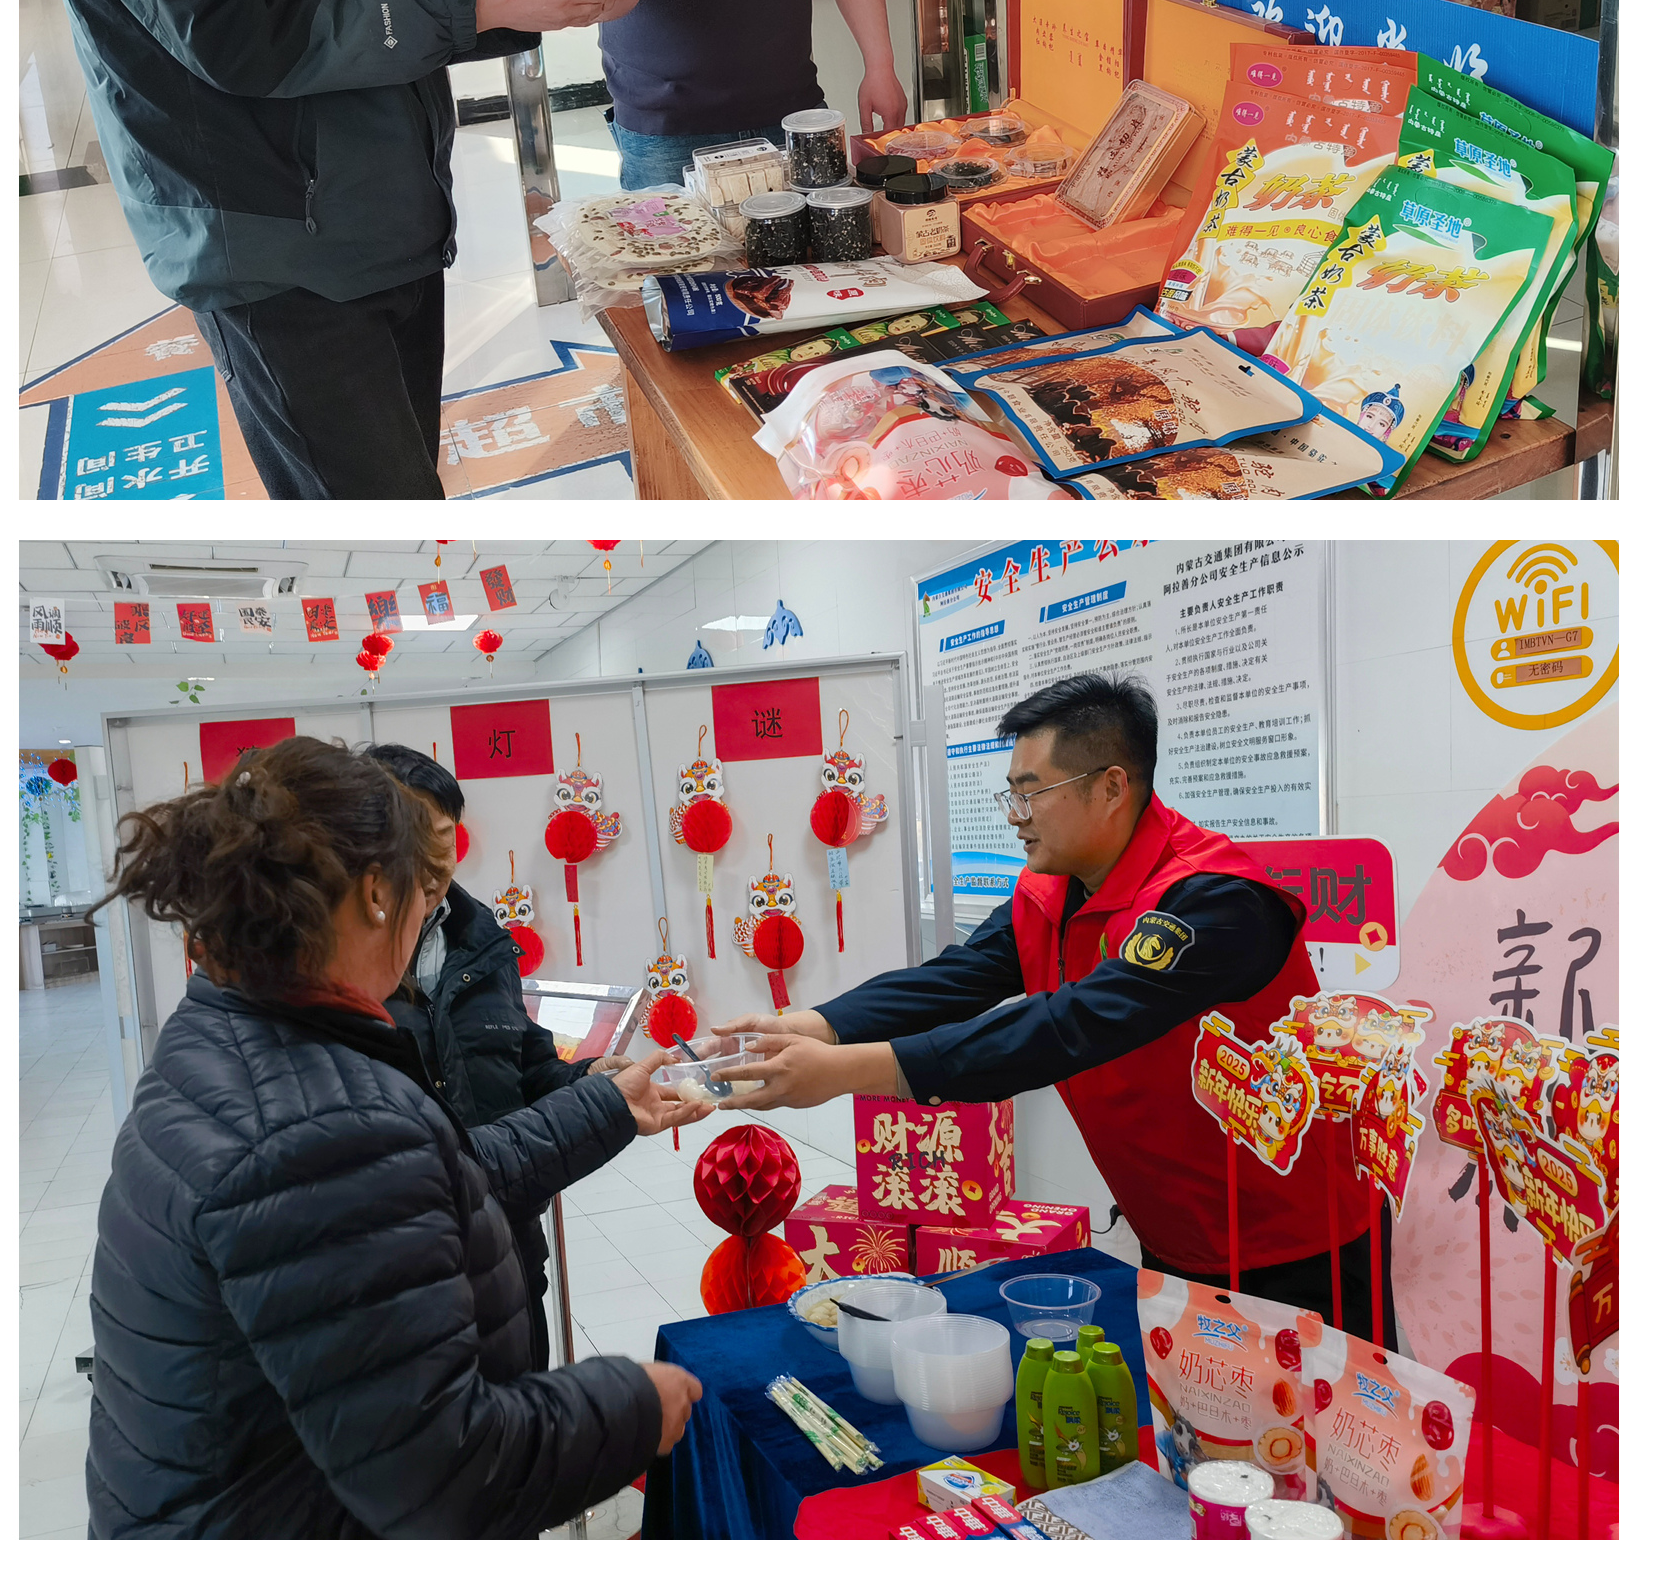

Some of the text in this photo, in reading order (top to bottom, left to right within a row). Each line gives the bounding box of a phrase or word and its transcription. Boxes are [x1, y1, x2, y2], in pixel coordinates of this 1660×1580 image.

[380, 2, 393, 35] FASHION
[1453, 137, 1512, 177] 草原圣地
[1202, 146, 1259, 234] 蒙古奶茶
[1242, 172, 1356, 211] 奶茶
[1226, 222, 1281, 239] 难得一见
[1400, 199, 1465, 239] 草原圣地
[1302, 224, 1384, 311] 蒙古奶茶
[1356, 259, 1490, 303] 奶茶
[76, 429, 207, 476] 卫生间
[74, 454, 209, 500] 开水间
[896, 450, 986, 500] 奶芯枣
[973, 540, 1148, 607] 安全生产公
[1163, 543, 1306, 596] 阿拉善分公司安全生产信息公示
[426, 592, 450, 613] 福
[1061, 591, 1109, 613] 安全生产管理制度
[1179, 581, 1284, 619] 主要负责人安全生产工作职责
[950, 625, 999, 647] 安全生产工作的指导思想
[1174, 605, 1268, 637] 1、所长是本单位安全生产第一责任
[1166, 653, 1268, 682] 于安全生产的各项制度、措施、决定有关
[1174, 638, 1268, 666] 2、贯彻执行国家与行业以及公司关
[1526, 660, 1564, 678] 无密码
[751, 707, 785, 740] 谜
[1167, 711, 1231, 726] 及时消除和报告安全隐患。
[487, 727, 516, 759] 灯
[1169, 772, 1247, 785] 充实、完善预案和应急救援措施。
[1142, 916, 1190, 943] 内蒙古交通集团
[1490, 909, 1603, 1056] 新
[1218, 1049, 1248, 1078] 2025
[1198, 1057, 1261, 1133] 新年快乐
[872, 1110, 963, 1162] 财源
[1358, 1127, 1401, 1184] 万事胜意
[888, 1152, 946, 1172] RICH
[1541, 1149, 1573, 1187] 2025
[872, 1168, 966, 1217] 滚滚
[799, 1225, 843, 1277] 大
[1178, 1348, 1255, 1400] 奶芯枣
[1178, 1381, 1252, 1414] NAIXINZAO
[1179, 1394, 1253, 1431] 奶+巴旦木+枣
[1330, 1406, 1404, 1472] 奶芯枣
[1323, 1456, 1389, 1508] 奶+巴旦木+枣
[1327, 1443, 1391, 1488] NAIXINZAO
